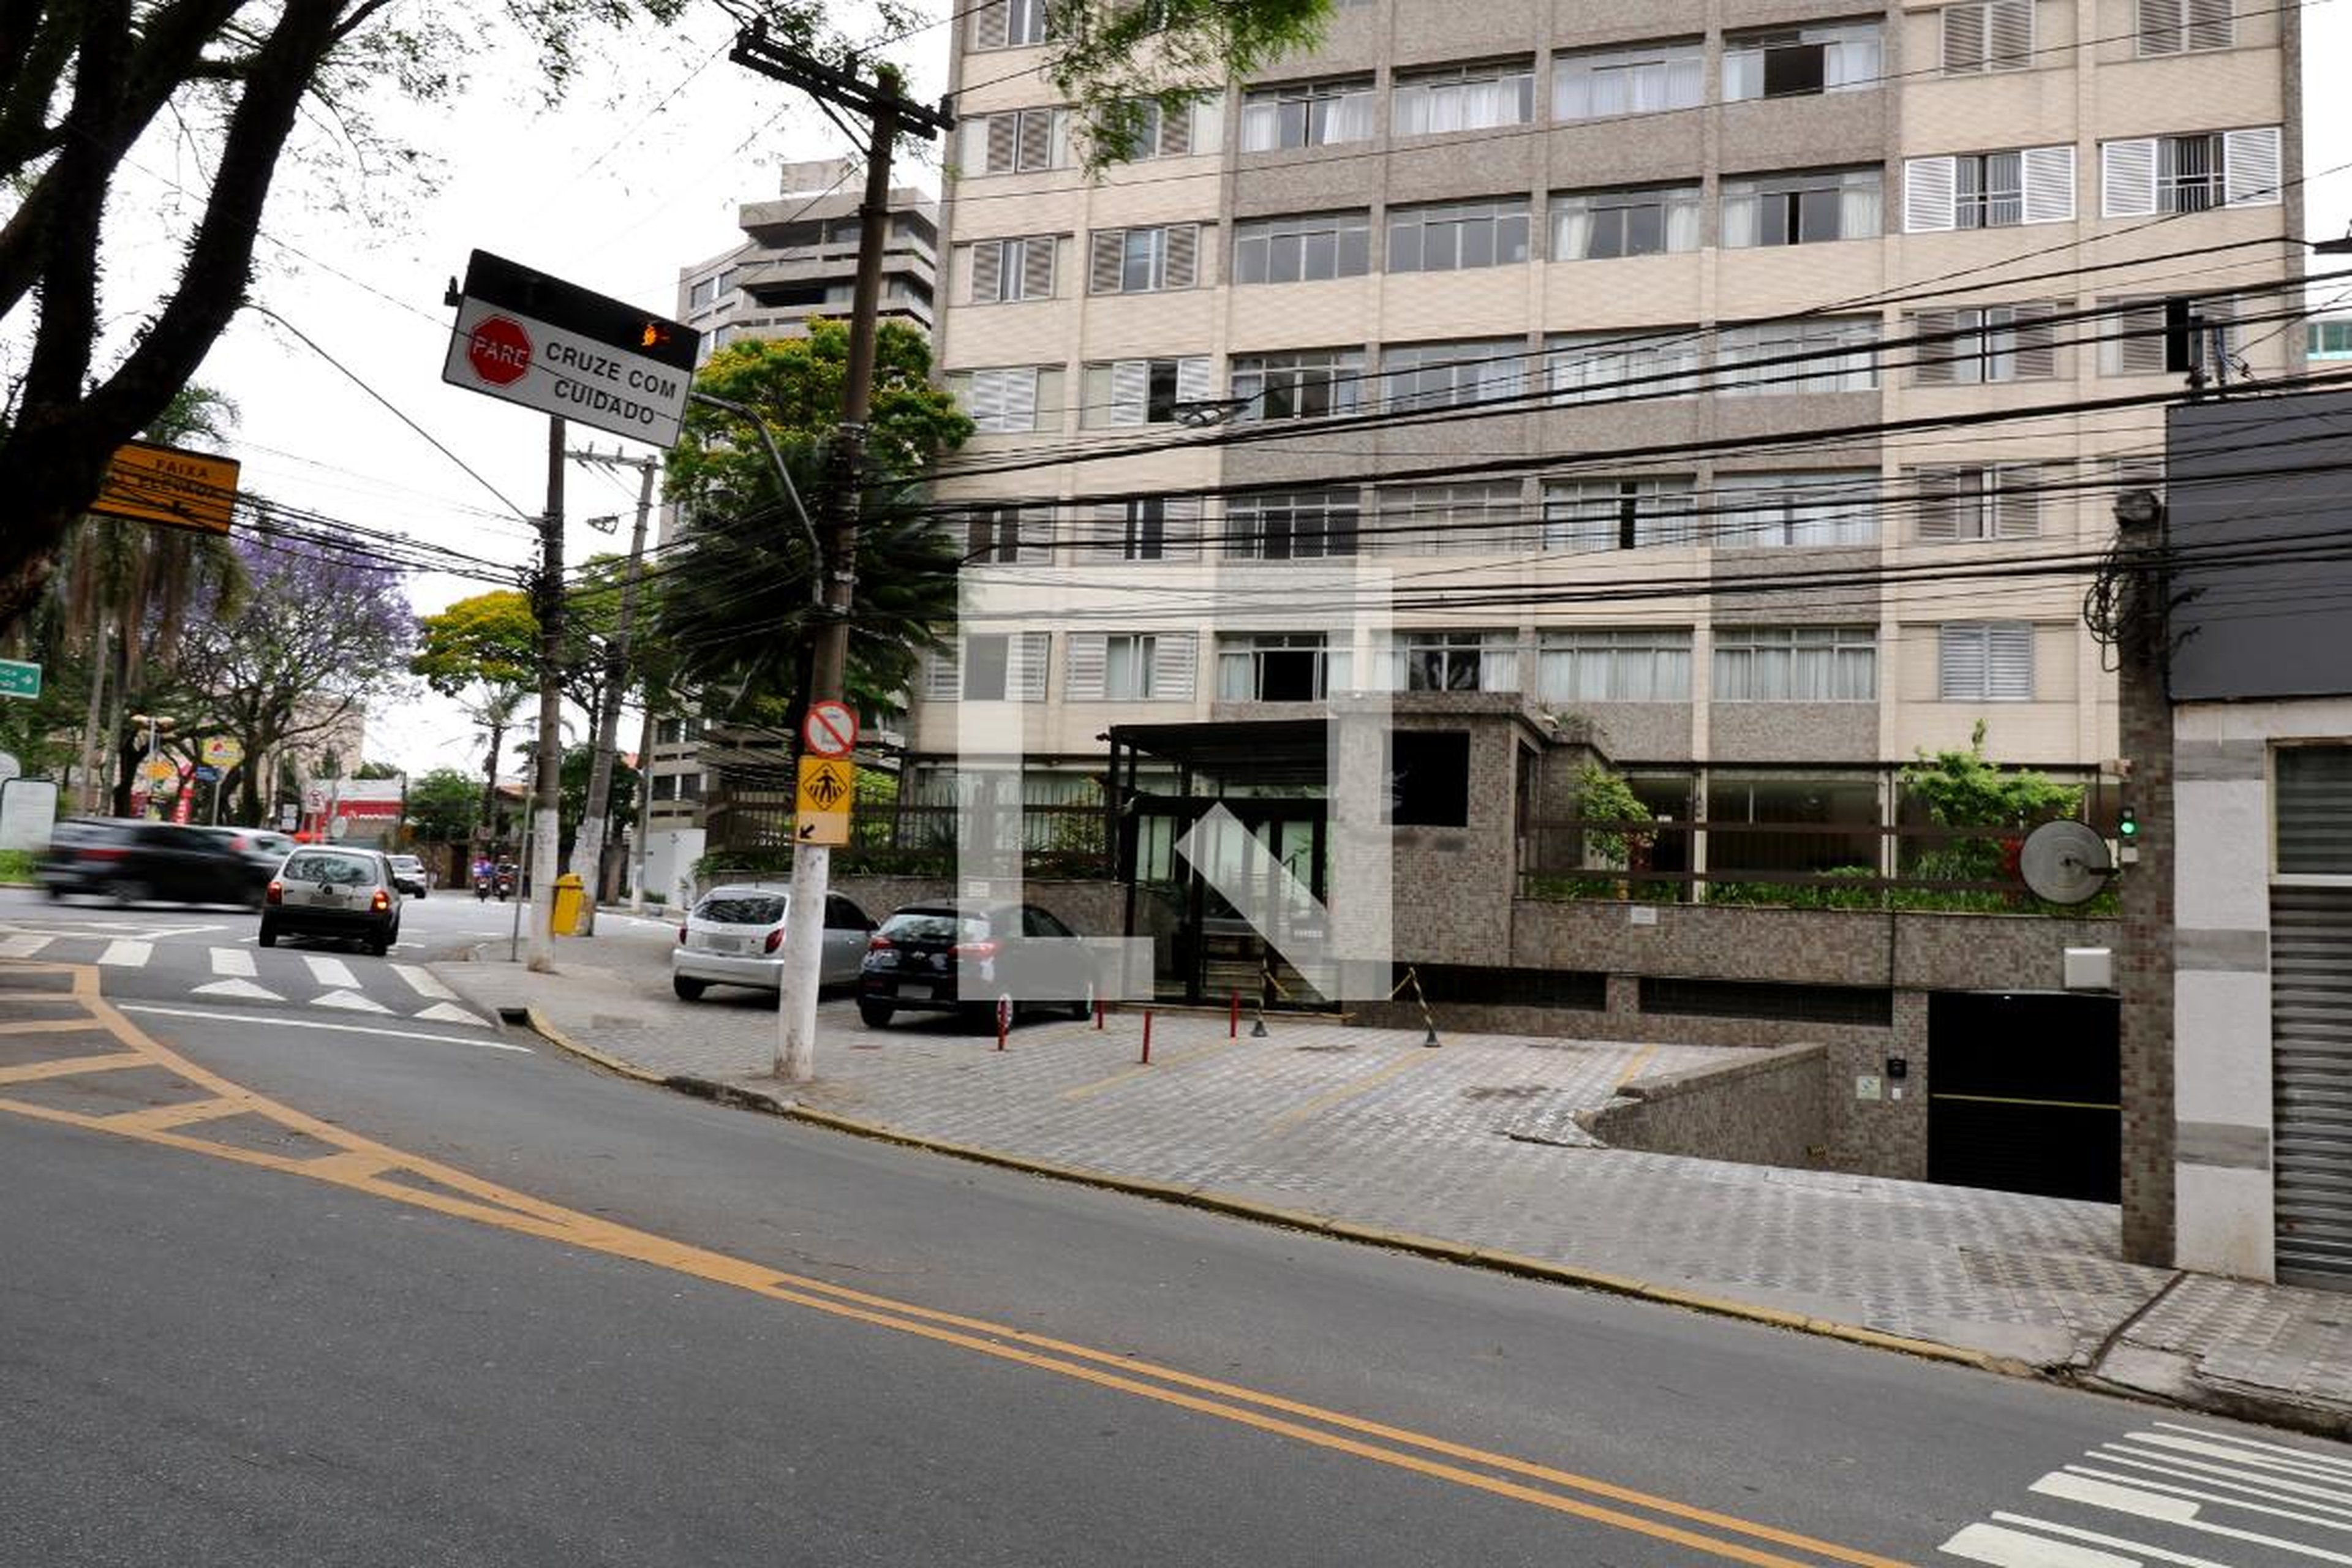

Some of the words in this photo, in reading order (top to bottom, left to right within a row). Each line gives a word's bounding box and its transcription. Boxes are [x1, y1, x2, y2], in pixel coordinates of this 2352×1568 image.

[472, 336, 528, 369] PARE
[545, 341, 622, 381] CRUZE
[628, 369, 677, 400] COM
[554, 378, 655, 425] CUIDADO
